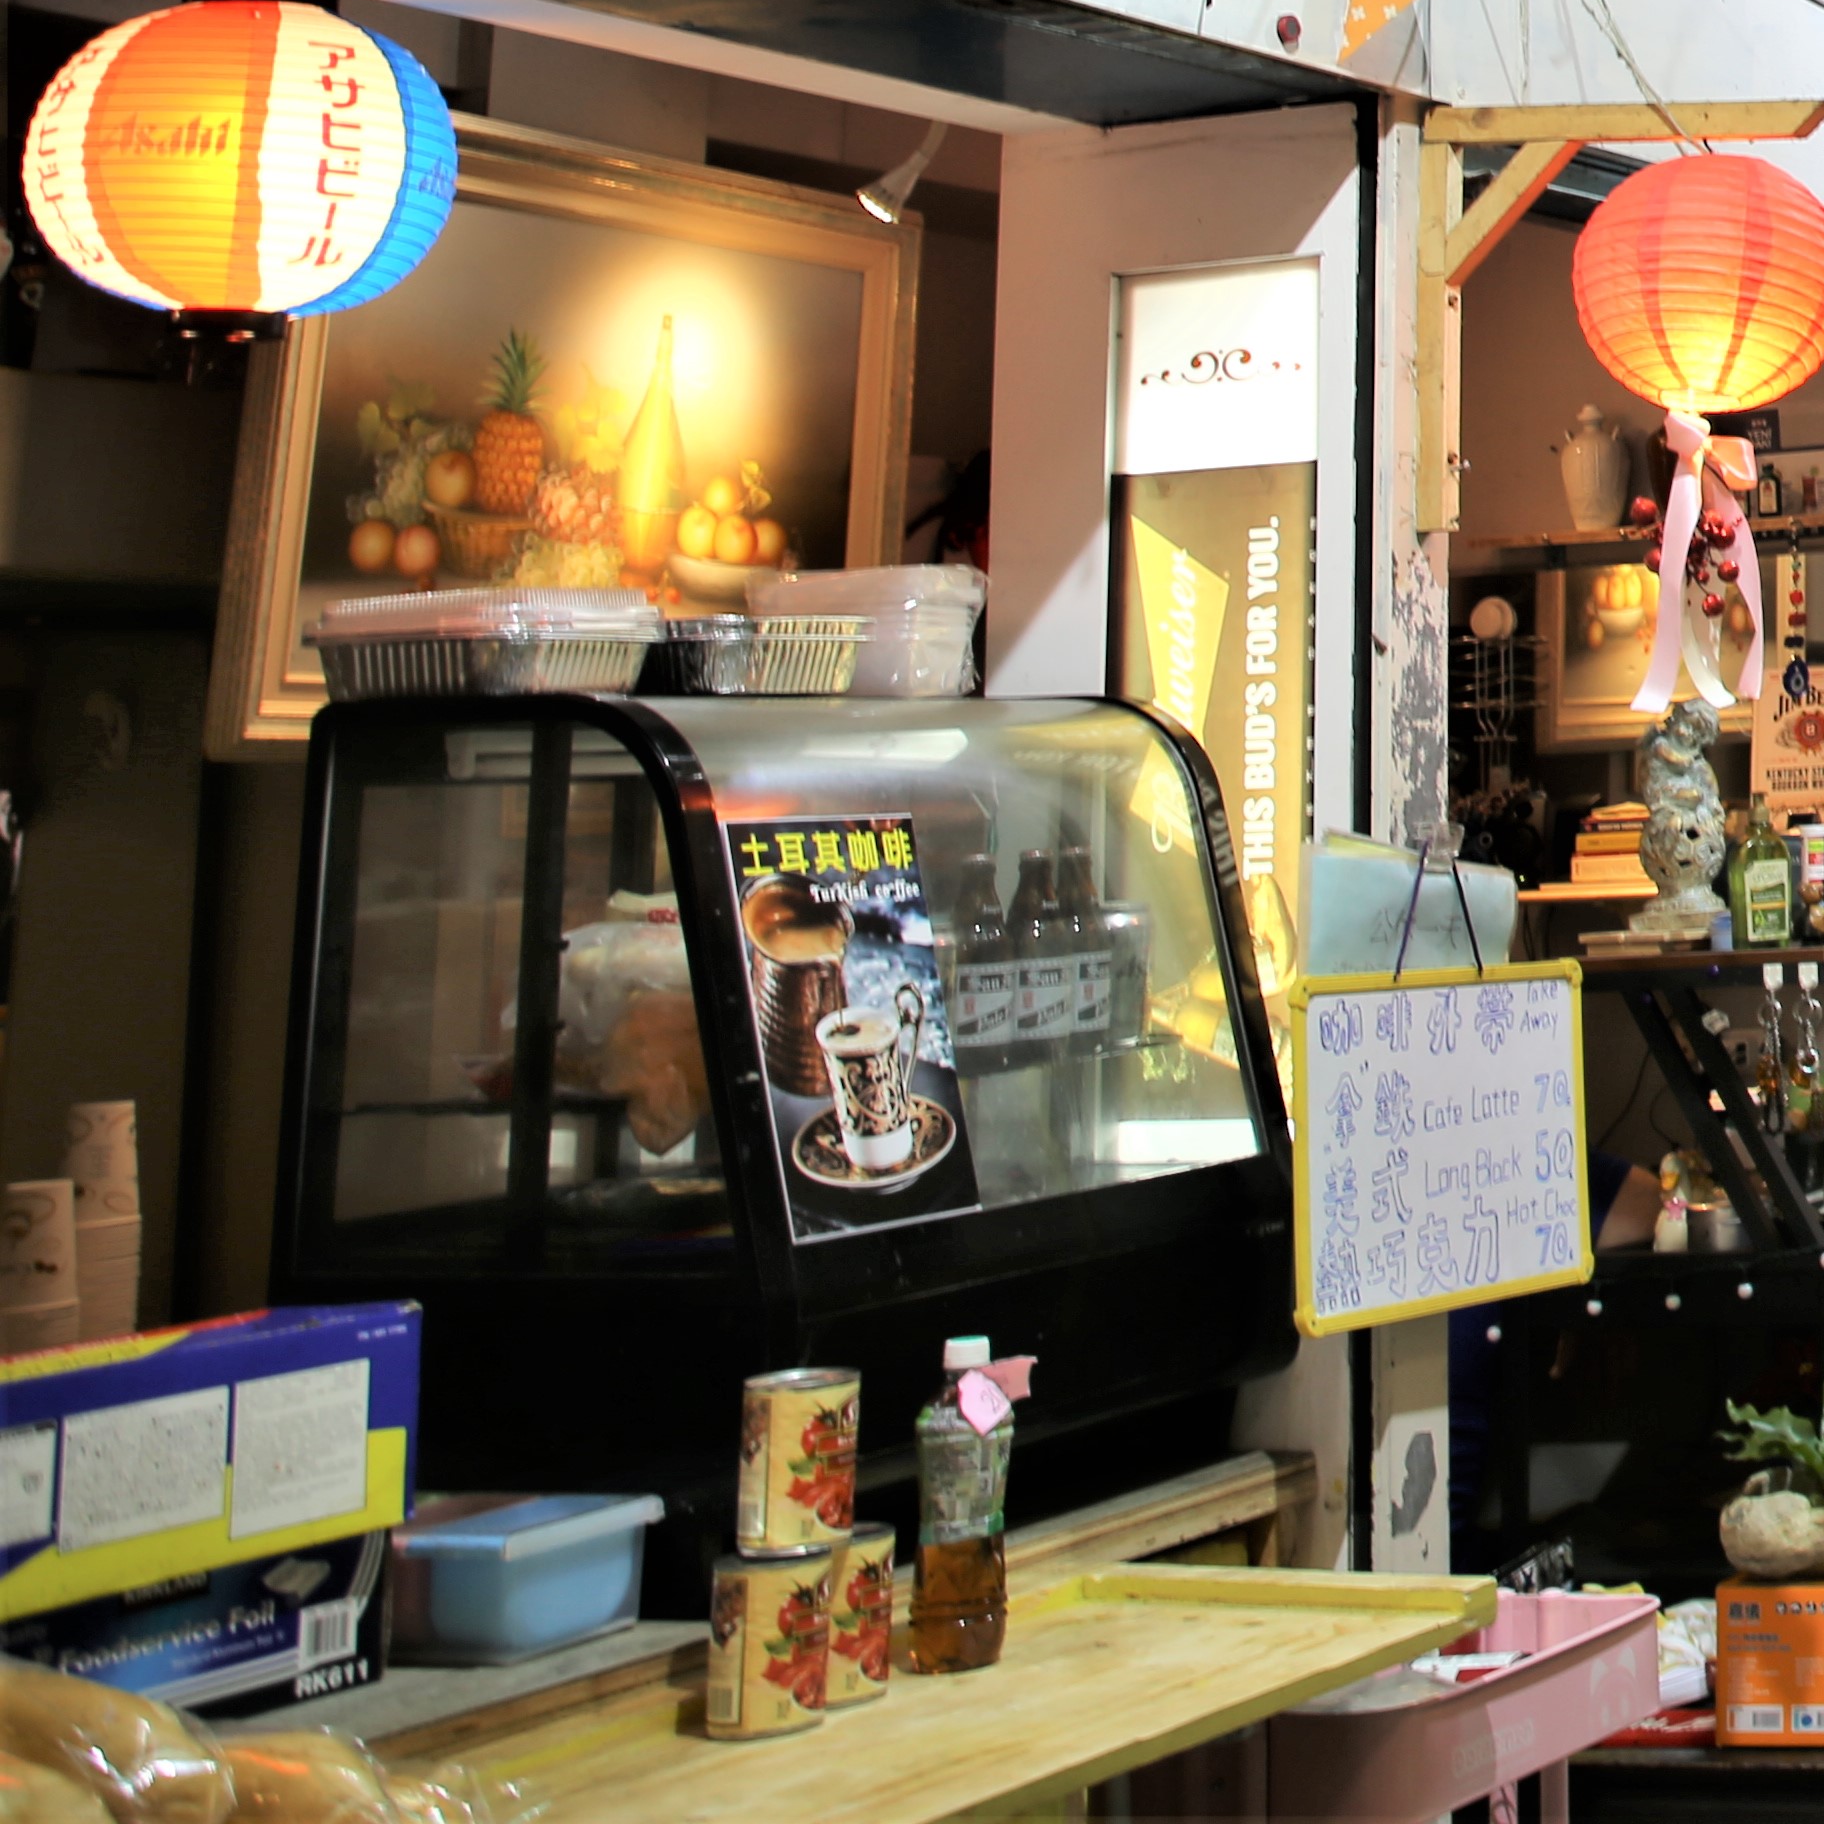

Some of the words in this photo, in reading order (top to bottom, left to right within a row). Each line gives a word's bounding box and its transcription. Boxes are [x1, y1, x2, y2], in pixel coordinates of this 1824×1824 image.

[100, 112, 230, 157] Asahi
[287, 39, 365, 267] アサヒビール
[1246, 514, 1281, 601] YOU.
[1245, 604, 1279, 676] FOR
[1766, 765, 1809, 778] KENTUCKY
[1771, 778, 1809, 790] BOURBON
[741, 827, 914, 877] 土耳其咖啡
[1243, 793, 1278, 882] THIS
[1323, 1148, 1414, 1238] 美式
[1506, 1198, 1540, 1229] Hot
[227, 1599, 277, 1635] Foil
